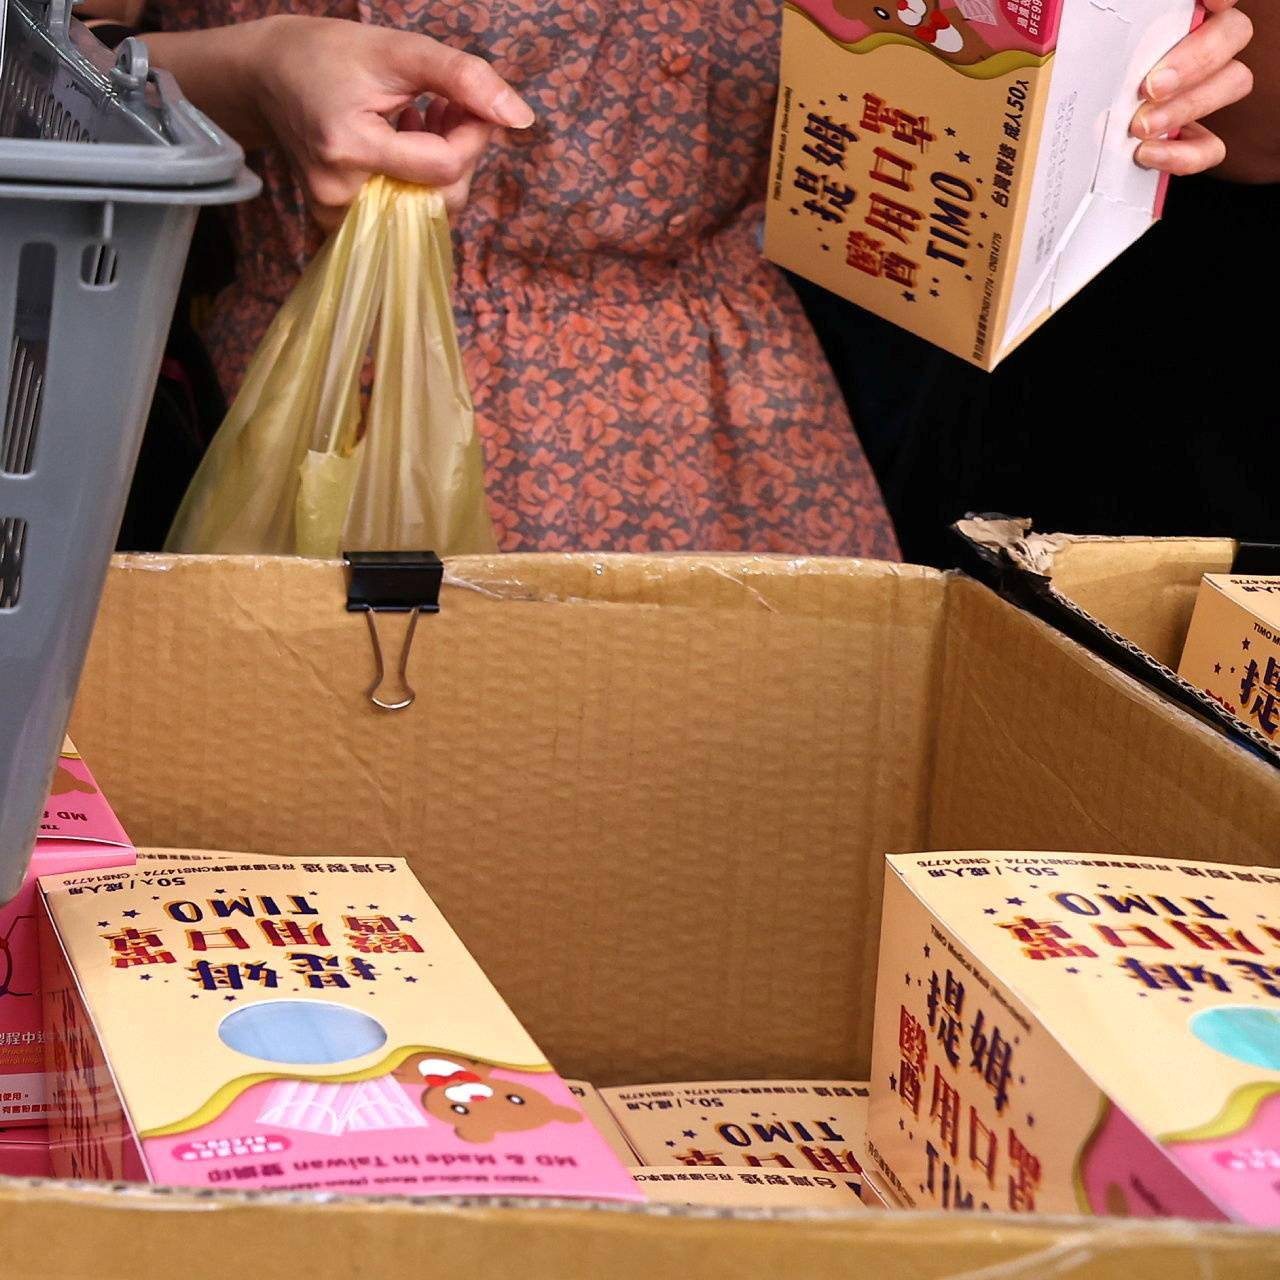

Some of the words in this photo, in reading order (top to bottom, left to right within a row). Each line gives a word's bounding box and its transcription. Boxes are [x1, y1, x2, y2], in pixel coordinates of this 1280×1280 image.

[792, 111, 860, 225] 提姆
[990, 144, 1017, 209] 台灣製造
[845, 91, 939, 289] 醫用口罩
[925, 170, 978, 269] TIMO
[1253, 622, 1272, 641] TIMO
[56, 811, 88, 822] MD
[301, 863, 397, 875] 台灣製造
[164, 893, 320, 924] TIMO
[1049, 892, 1230, 921] TIMO
[98, 913, 426, 970] 醫用口罩
[186, 951, 384, 991] 提姆
[716, 1120, 846, 1148] TIMO
[292, 1150, 390, 1172] Taiwan
[392, 1153, 415, 1167] In
[424, 1151, 497, 1168] Made
[534, 1153, 578, 1169] MD
